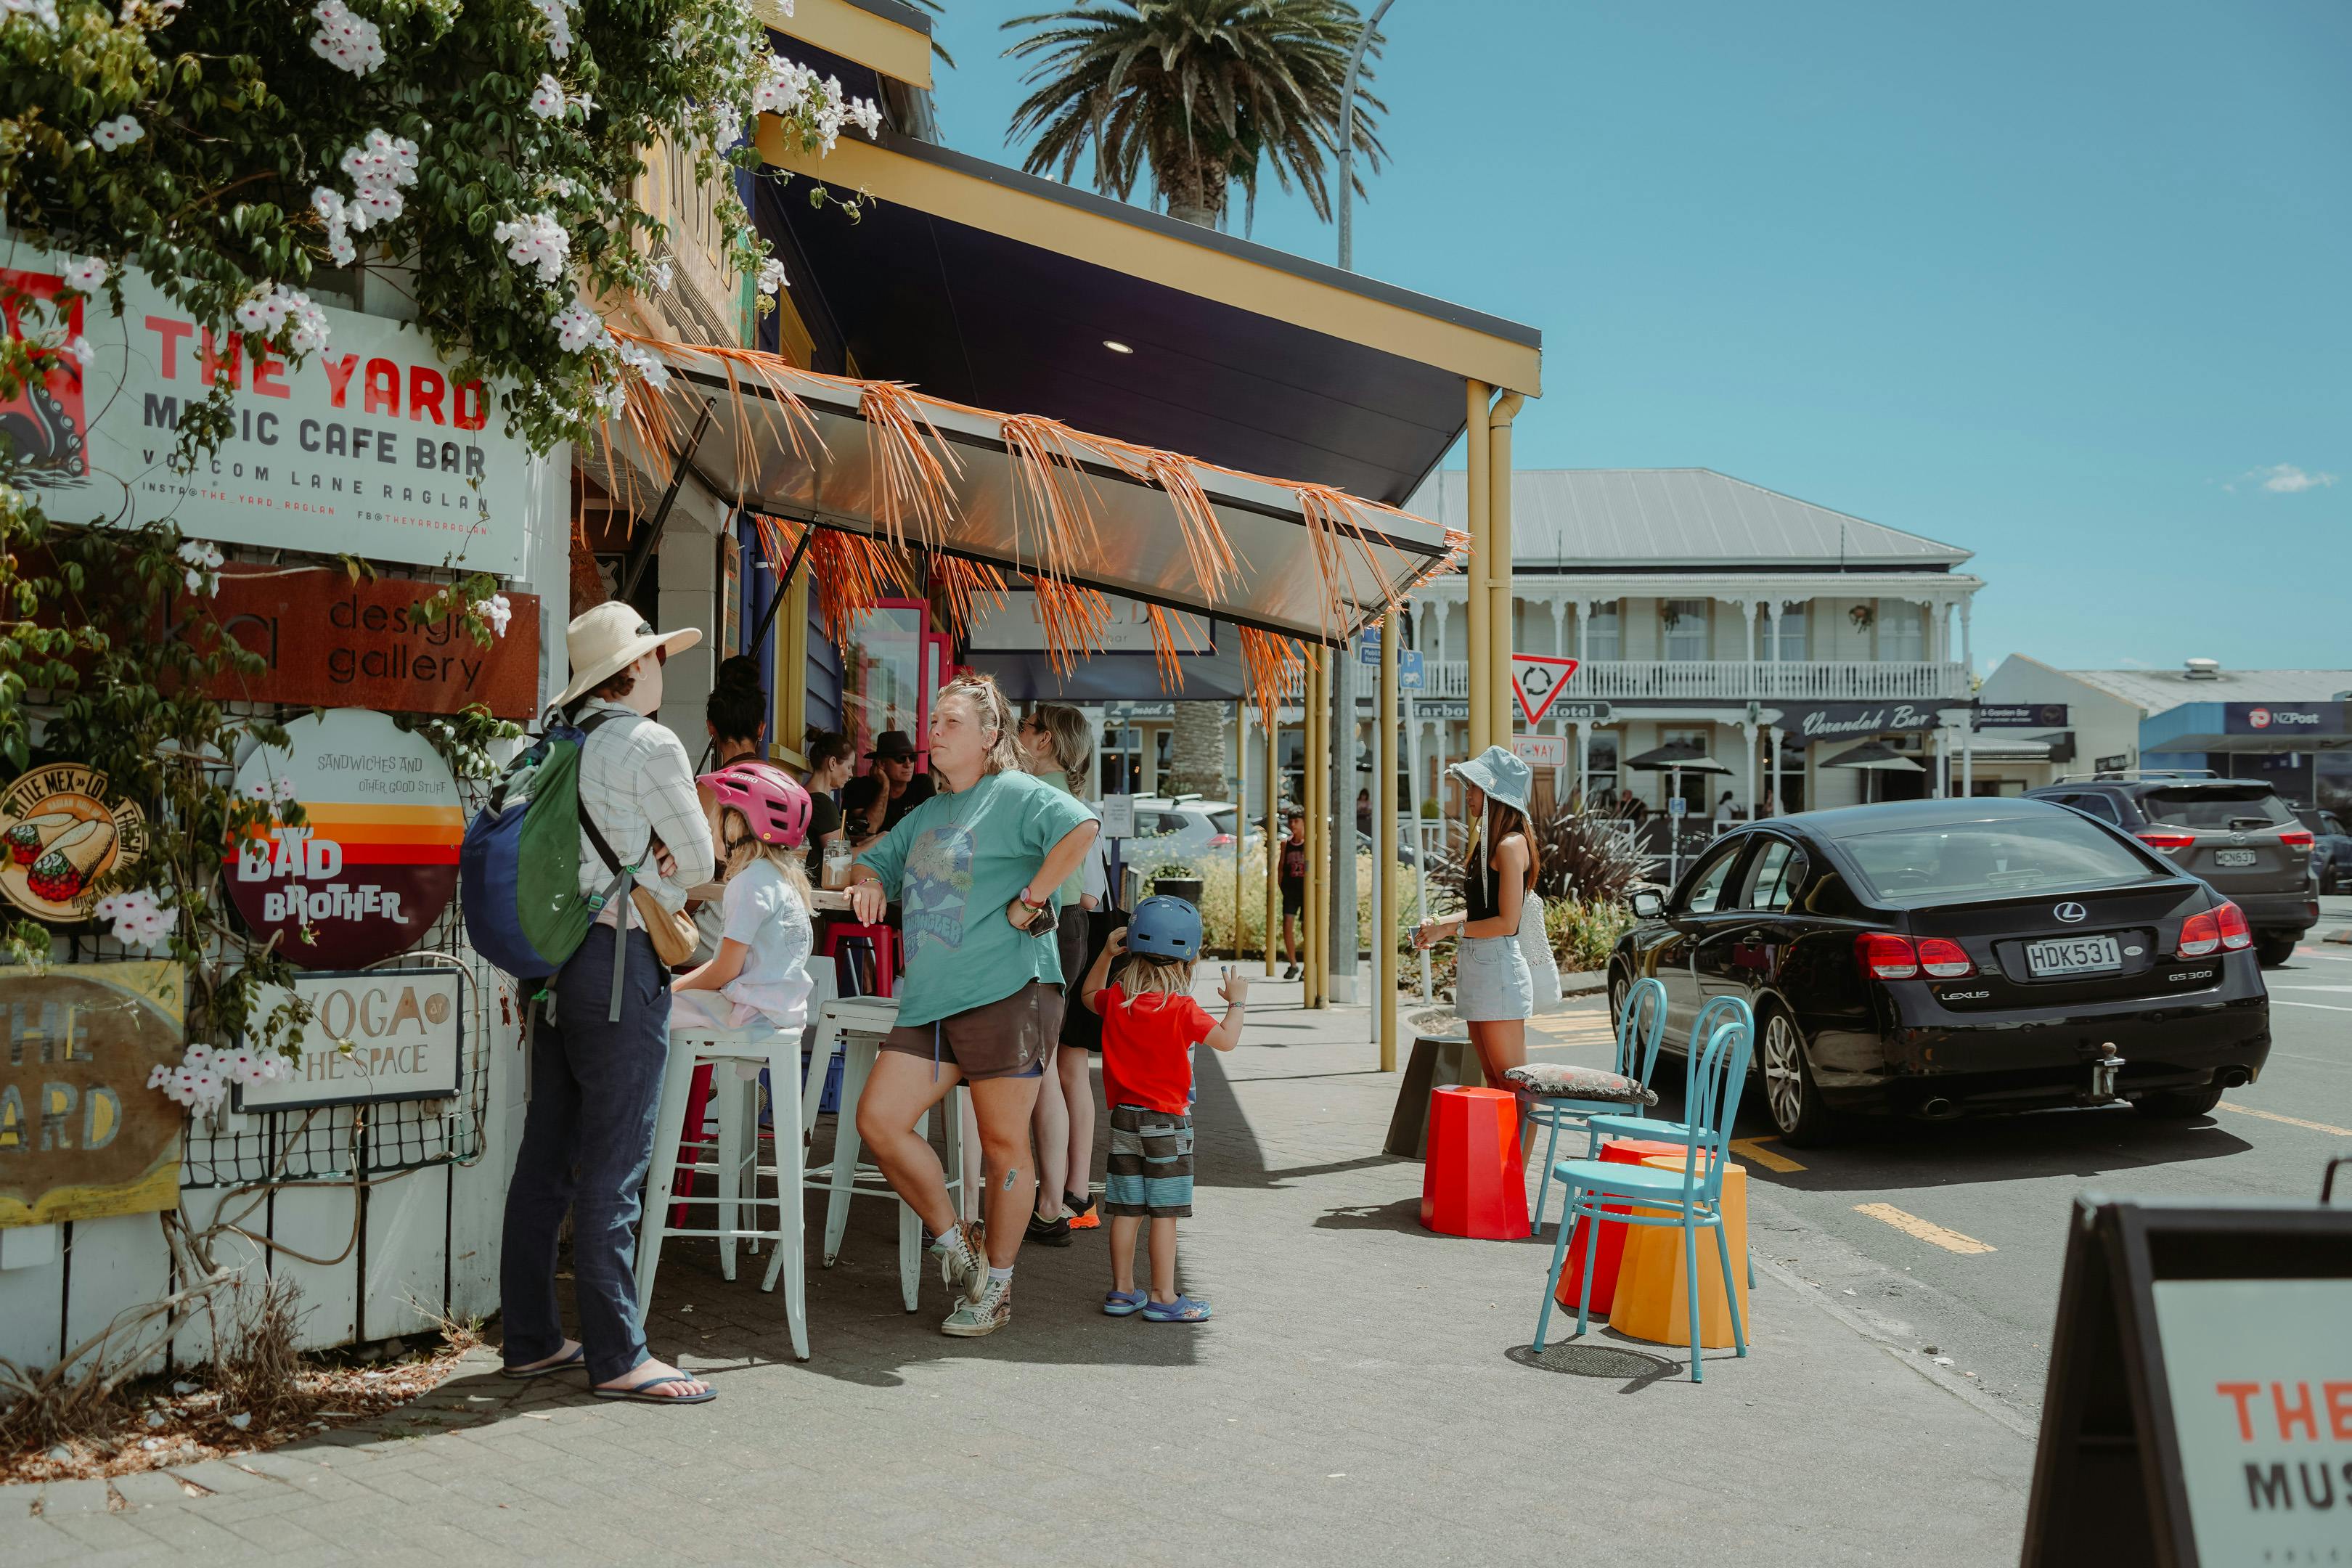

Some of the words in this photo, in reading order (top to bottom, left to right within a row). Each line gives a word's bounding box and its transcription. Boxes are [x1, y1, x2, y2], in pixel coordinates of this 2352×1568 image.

[144, 315, 290, 399] THE
[321, 353, 491, 430] YARD
[144, 392, 279, 446] MIC
[299, 418, 397, 464] CAFE
[416, 437, 486, 476] BAR
[143, 449, 269, 481] VOCOM
[291, 470, 363, 494] LANE
[383, 484, 488, 513] RAGLAN
[328, 644, 482, 692] gallery
[1413, 704, 1469, 716] arbo
[1548, 704, 1596, 717] Hotel
[1802, 709, 1885, 736] Verandah
[1890, 704, 1930, 729] Bar
[318, 754, 396, 773] SANDWICHES
[399, 756, 422, 774] AND
[1532, 744, 1555, 758] WAY
[44, 770, 75, 795] MEX
[359, 778, 387, 794] OTHER
[389, 780, 415, 794] GOOD
[418, 780, 446, 796] STUFF
[237, 827, 342, 882] BAD
[264, 883, 409, 925] BROTHER
[2033, 941, 2115, 968] HDK531
[2189, 970, 2213, 979] 300
[1941, 990, 1990, 1000] LEXUS
[0, 1000, 94, 1066] HE
[290, 1050, 345, 1082] HE
[354, 1044, 428, 1078] SPACE
[2216, 1382, 2352, 1442] THE
[2245, 1463, 2352, 1511] MU
